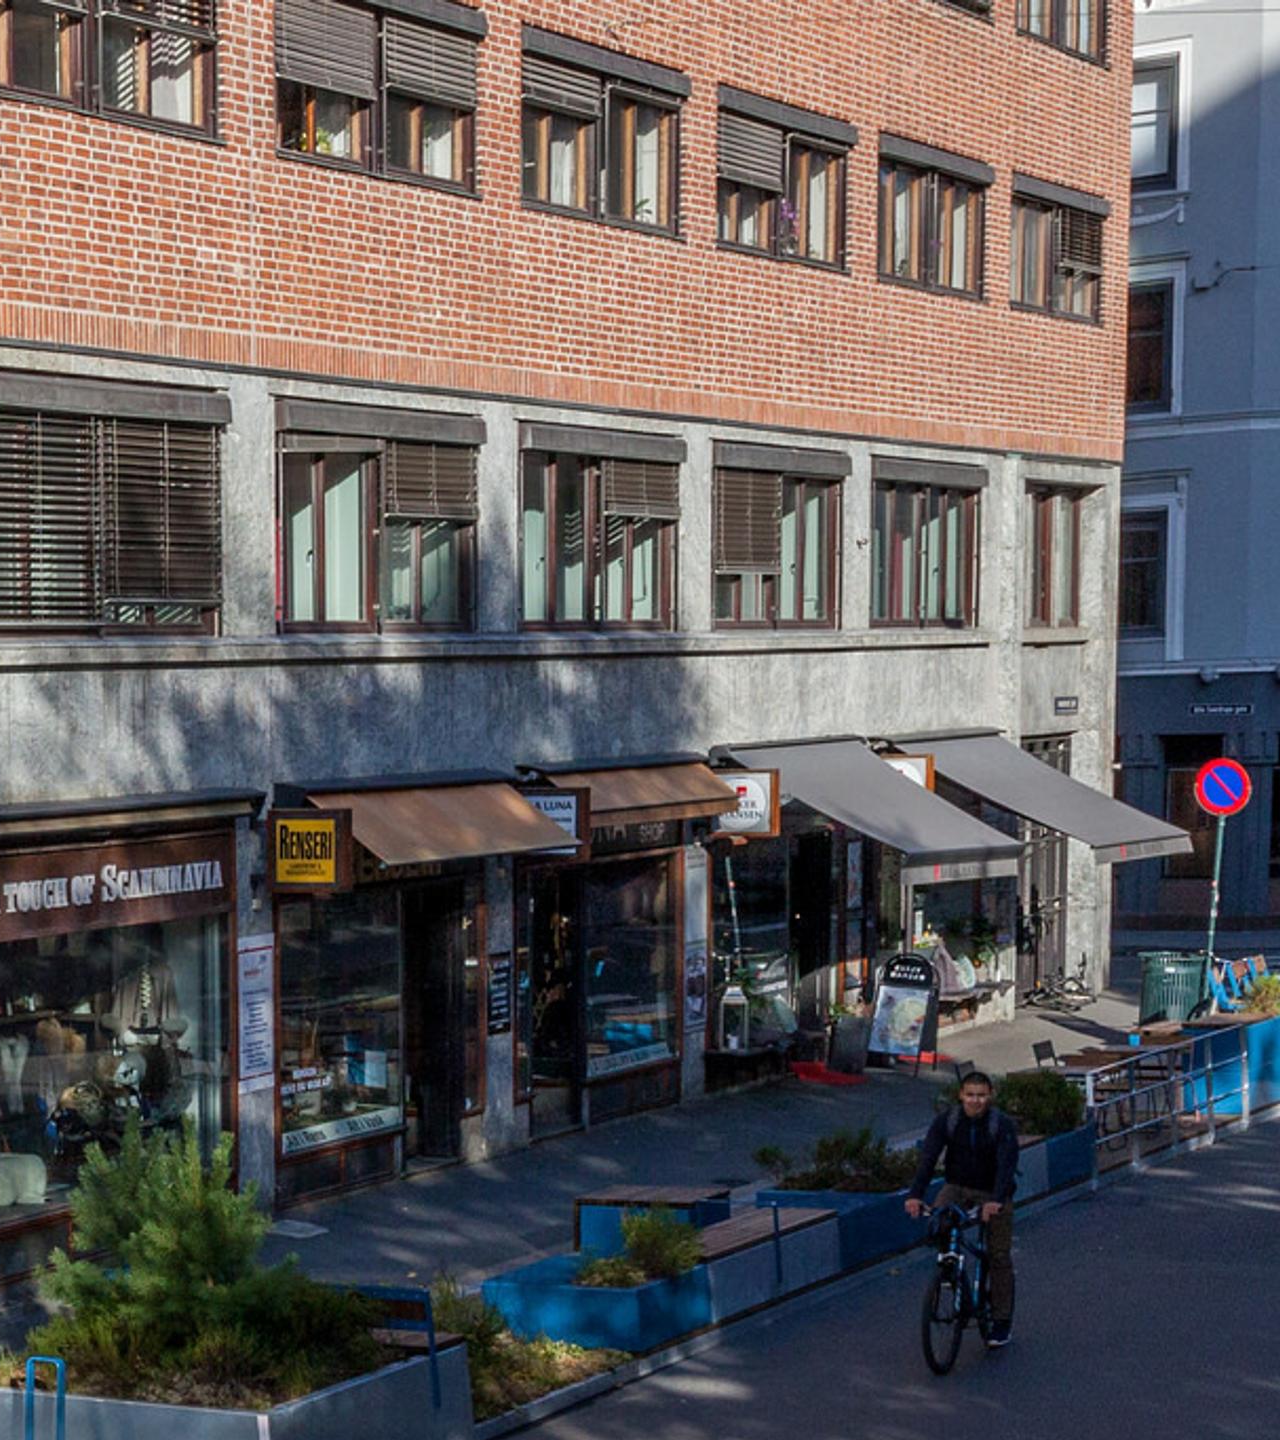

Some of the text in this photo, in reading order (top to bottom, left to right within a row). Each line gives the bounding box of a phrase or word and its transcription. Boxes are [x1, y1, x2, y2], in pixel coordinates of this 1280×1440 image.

[543, 800, 572, 811] LUNA
[280, 824, 332, 860] RENSERI
[3, 877, 69, 914] TOUCH
[71, 874, 96, 906] OF
[101, 861, 224, 902] SCANDINAVIA
